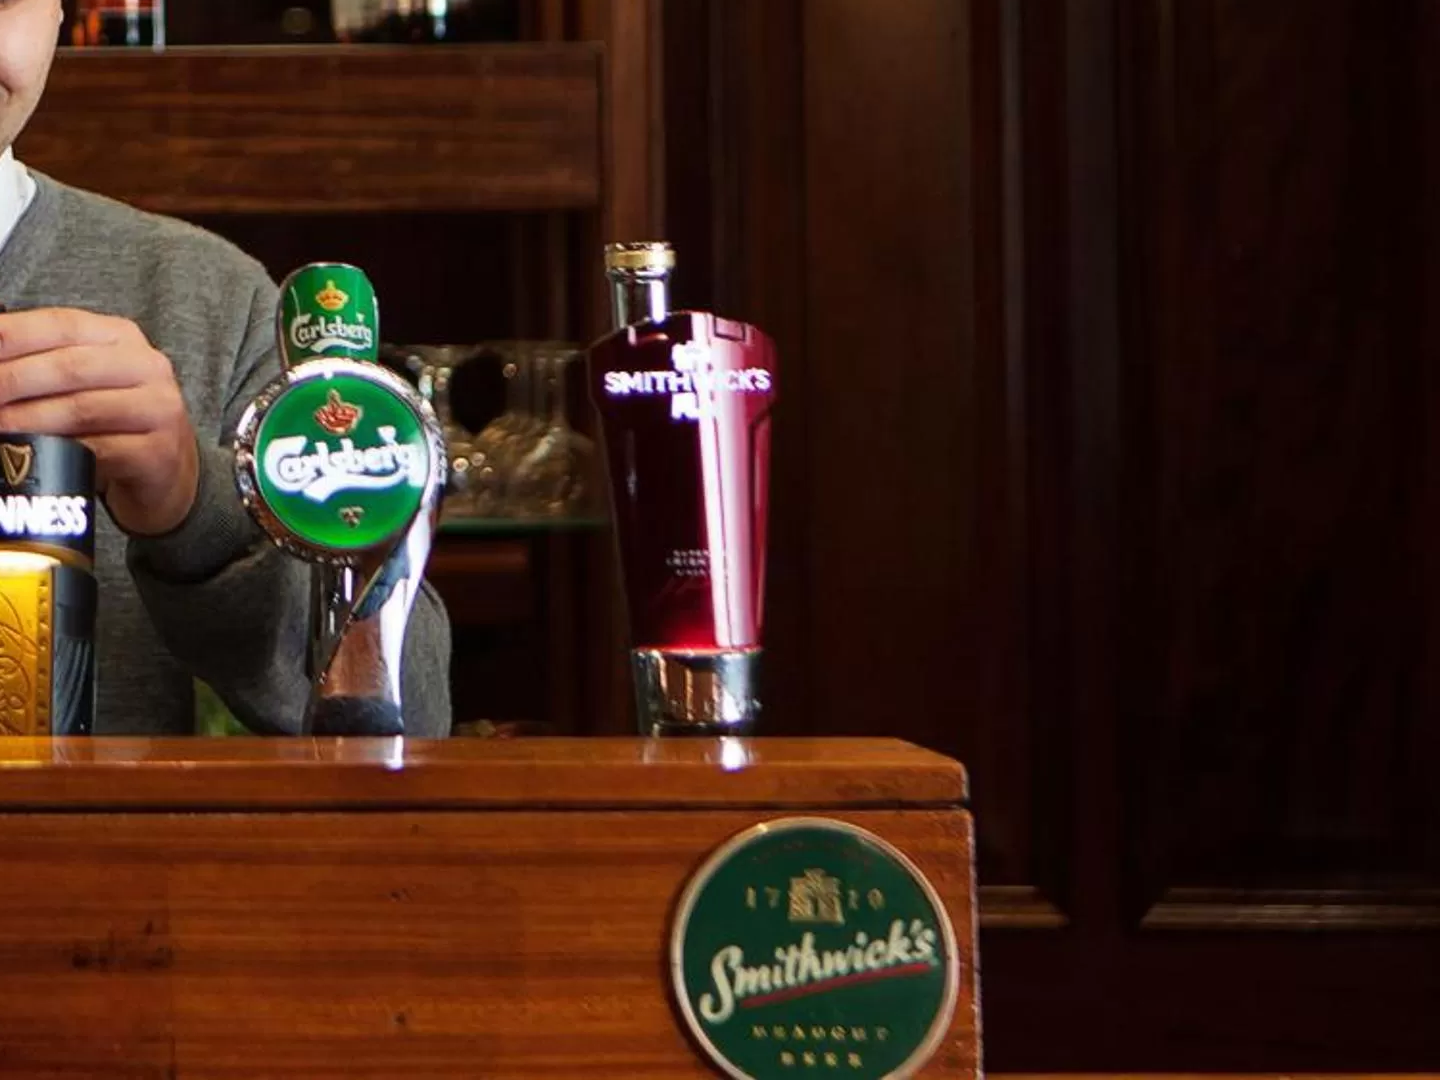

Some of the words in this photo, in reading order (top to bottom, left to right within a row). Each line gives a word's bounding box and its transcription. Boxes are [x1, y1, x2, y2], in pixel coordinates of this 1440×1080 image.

[290, 313, 373, 352] Carlsberg
[263, 426, 422, 502] Carlsberg
[699, 919, 936, 1022] Smithwick's
